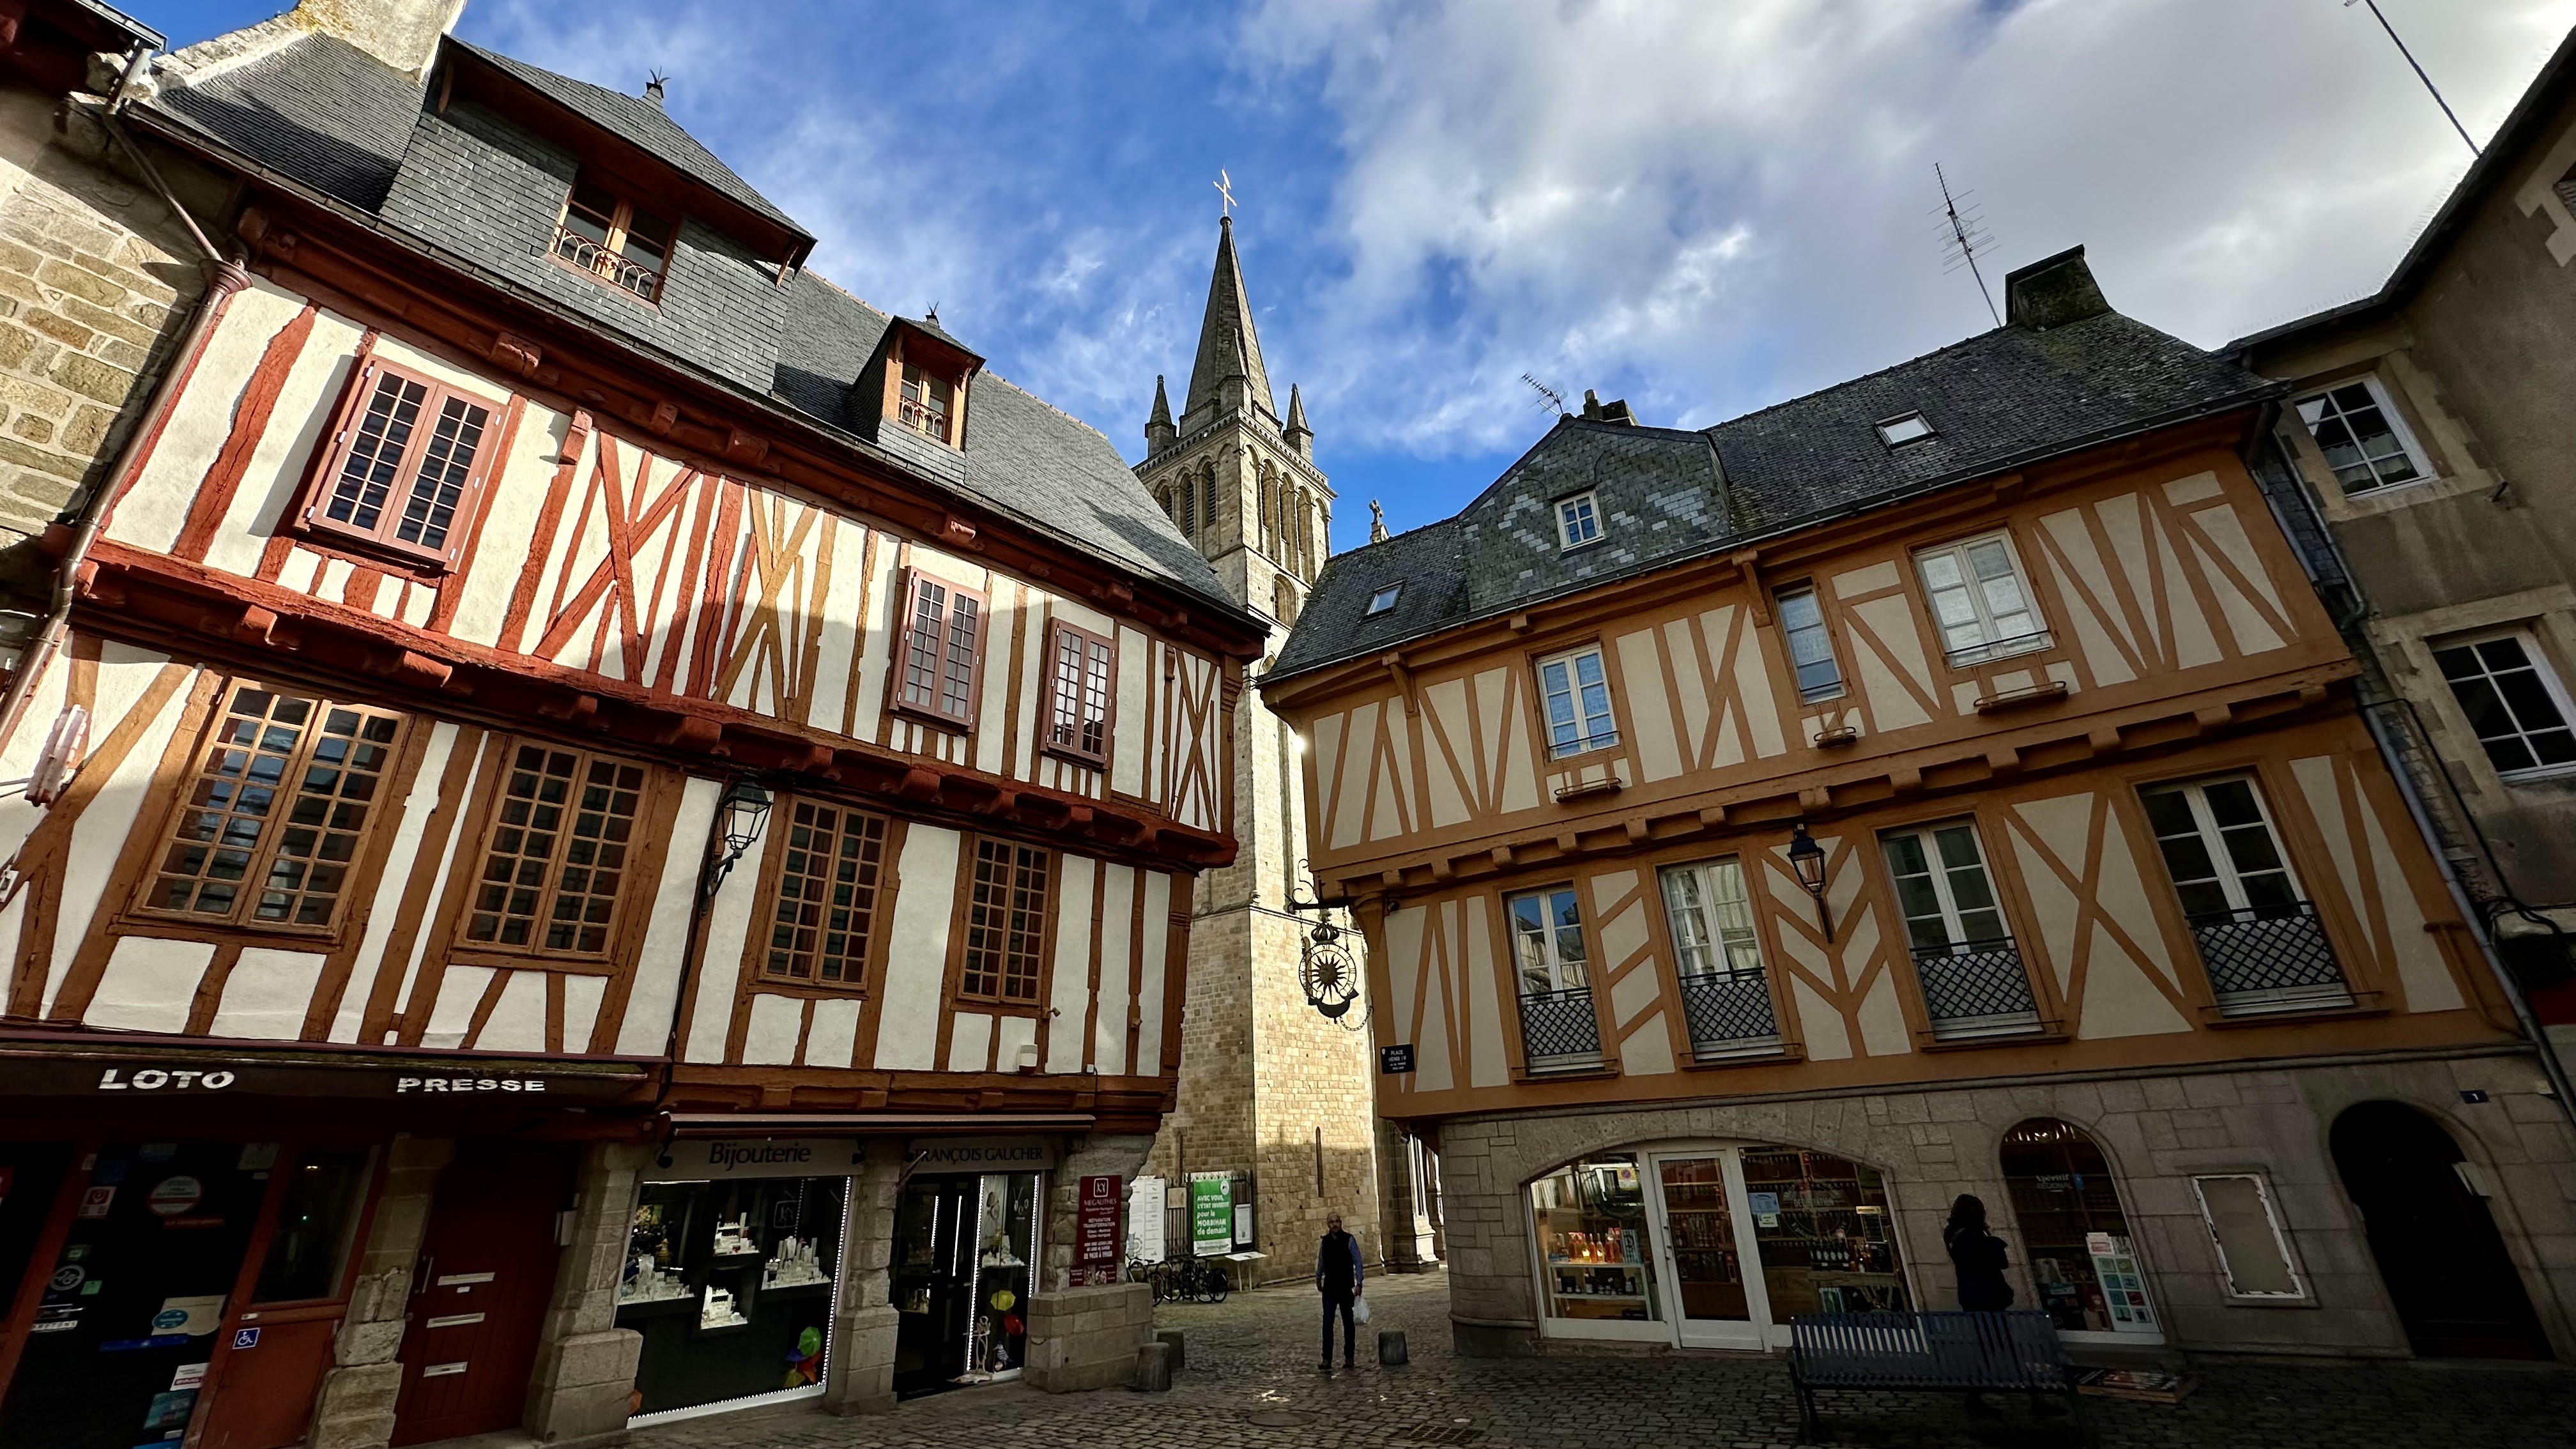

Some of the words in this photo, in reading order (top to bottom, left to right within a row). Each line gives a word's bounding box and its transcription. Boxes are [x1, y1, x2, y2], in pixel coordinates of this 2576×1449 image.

[98, 1069, 234, 1089] LOTO
[397, 1077, 545, 1092] PRESSE
[709, 1143, 811, 1172] Bijouterie
[916, 1148, 981, 1165] FRANÇOIS
[985, 1147, 1043, 1162] GAUCHER
[1197, 1211, 1209, 1220] pour
[1197, 1218, 1226, 1227] MORBIHAN
[1197, 1227, 1206, 1235] de
[1206, 1225, 1226, 1235] demain
